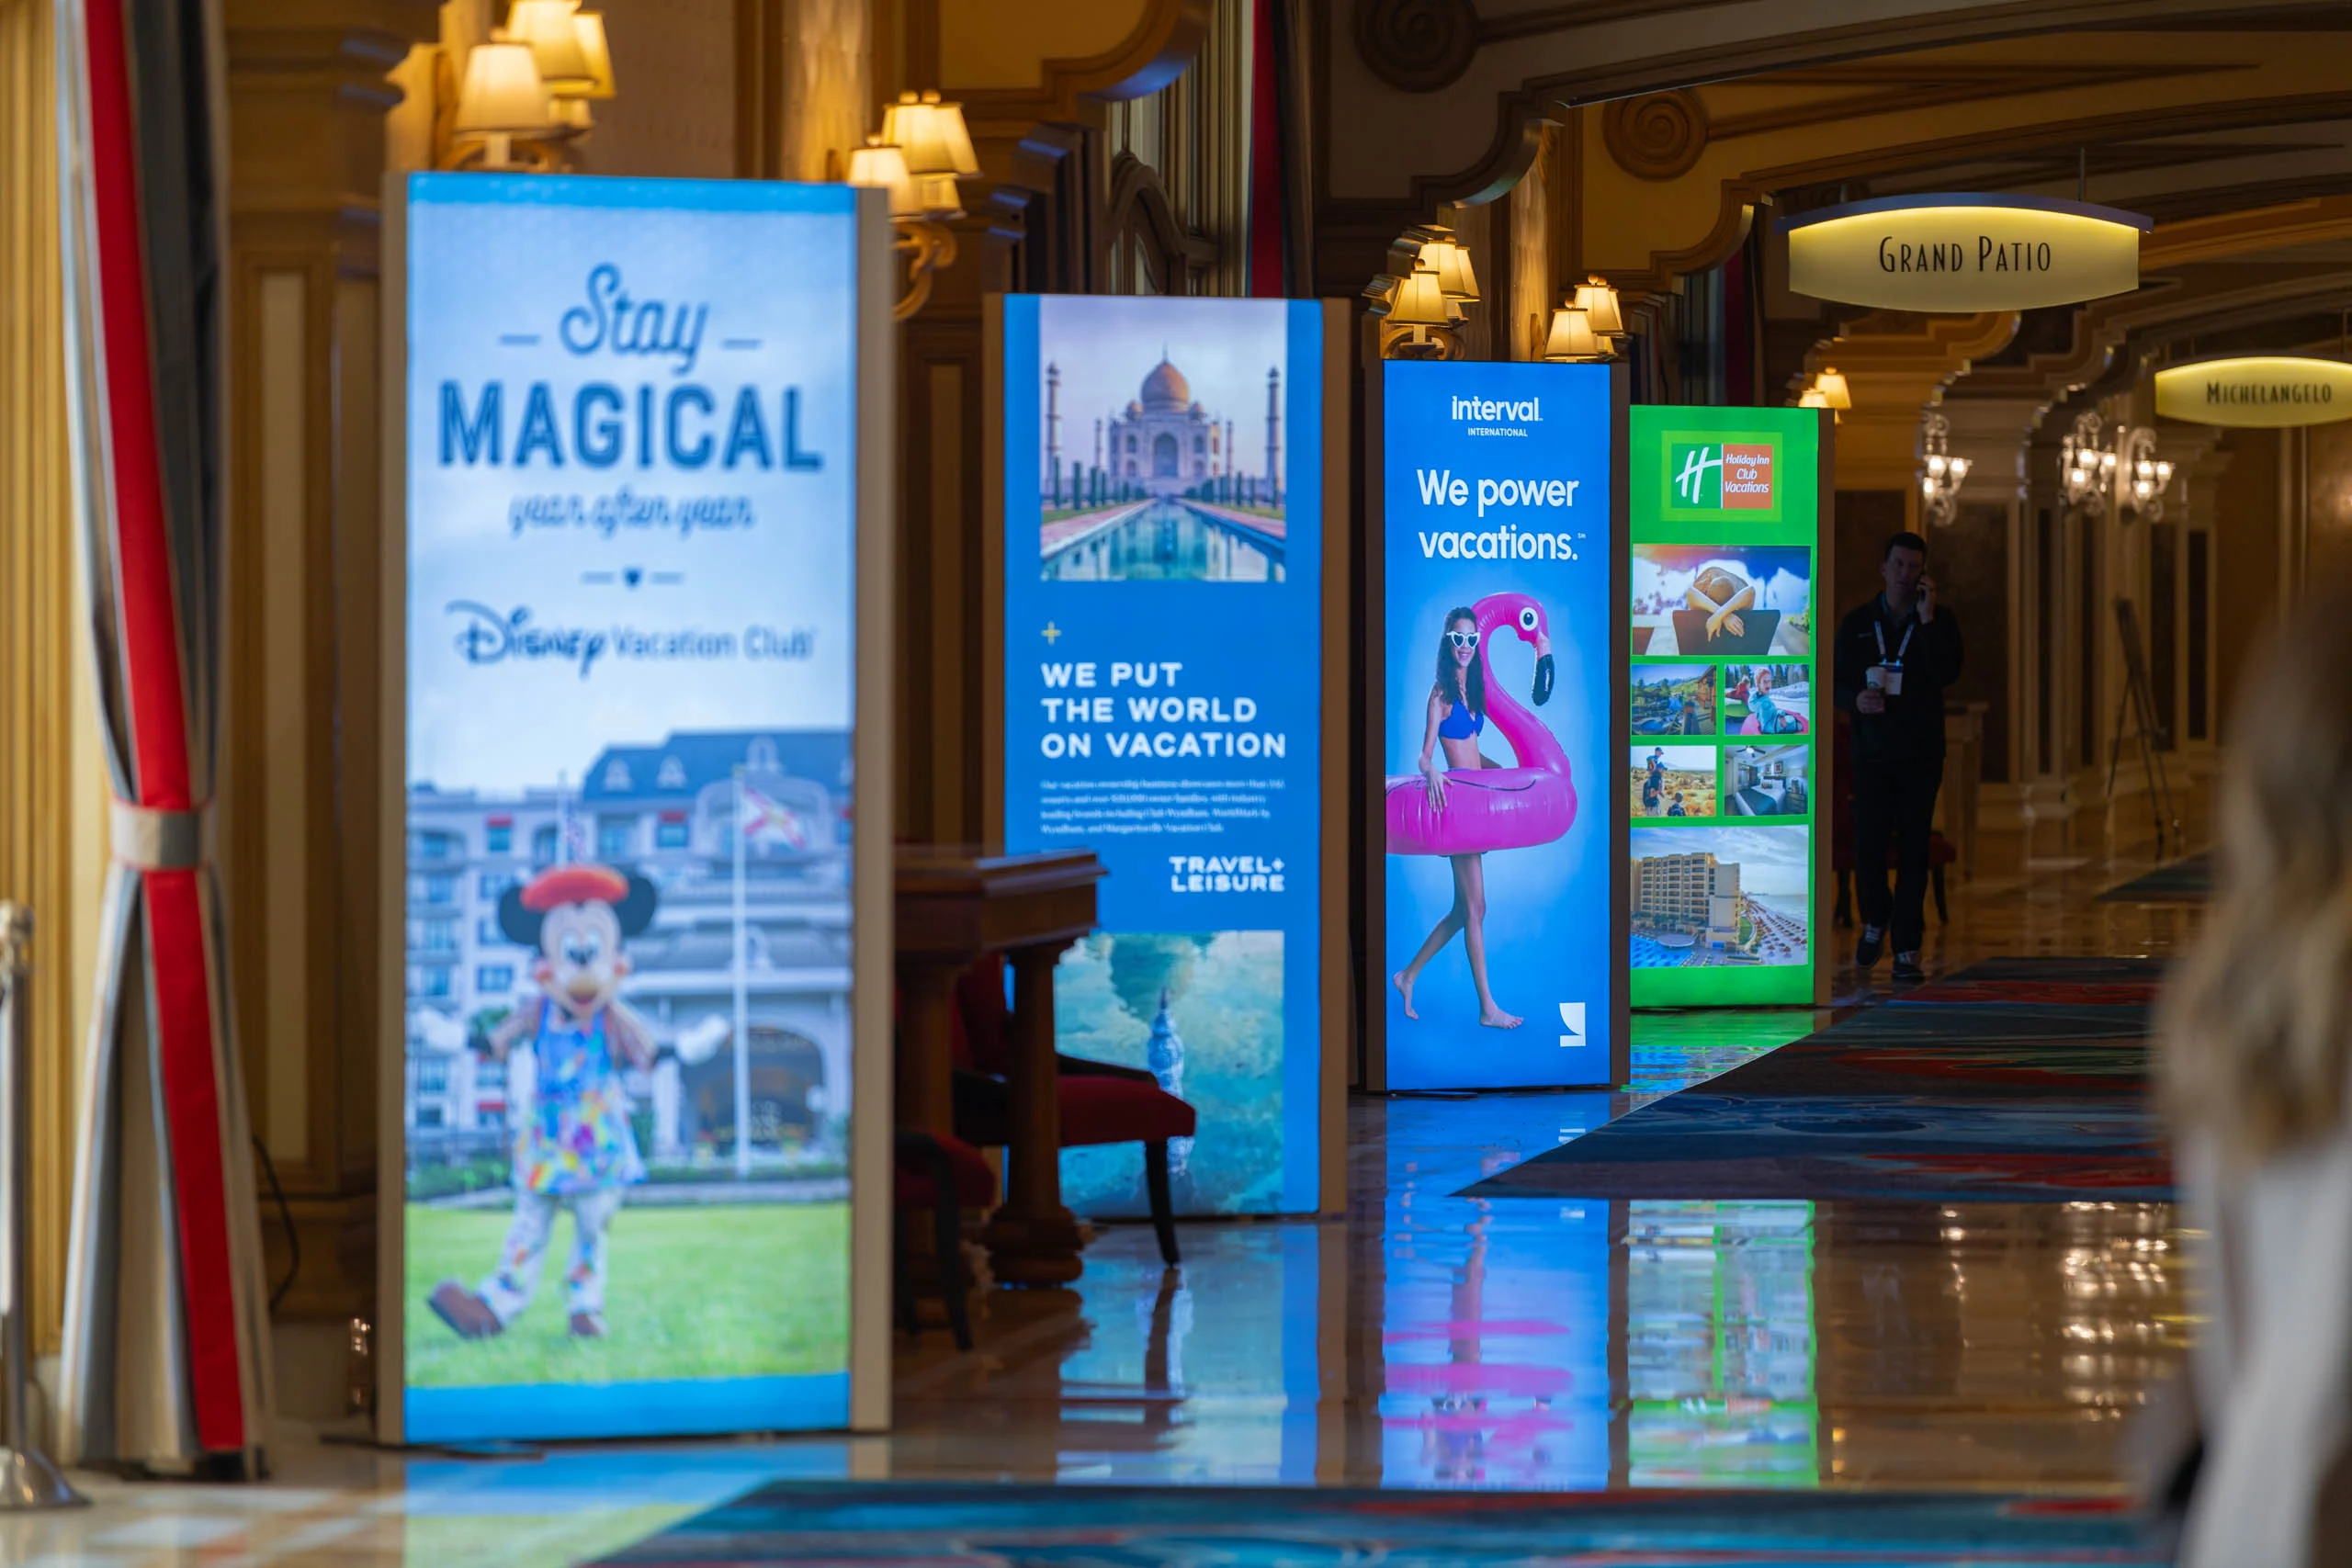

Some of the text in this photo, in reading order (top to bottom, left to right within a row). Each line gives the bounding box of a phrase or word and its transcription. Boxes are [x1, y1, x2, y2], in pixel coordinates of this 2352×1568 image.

[1879, 236, 2052, 273] GRAND PATIO
[560, 262, 709, 376] Stay
[2206, 382, 2333, 405] MICHELANGELO
[1453, 396, 1540, 421] interval
[439, 380, 825, 473] MAGICAL
[1468, 428, 1527, 436] INTERNATIONAL
[1725, 454, 1770, 467] Holiday Inn
[1736, 468, 1757, 479] Club
[1417, 469, 1579, 517] We power
[1725, 481, 1769, 492] Vacations
[1419, 524, 1578, 559] vacations.
[445, 600, 814, 679] Disney Vacation Club
[1042, 662, 1182, 687] WE PUT
[1042, 697, 1256, 722] THE WORLD
[1042, 732, 1284, 758] ON VACATION
[1171, 874, 1283, 892] LEISURE
